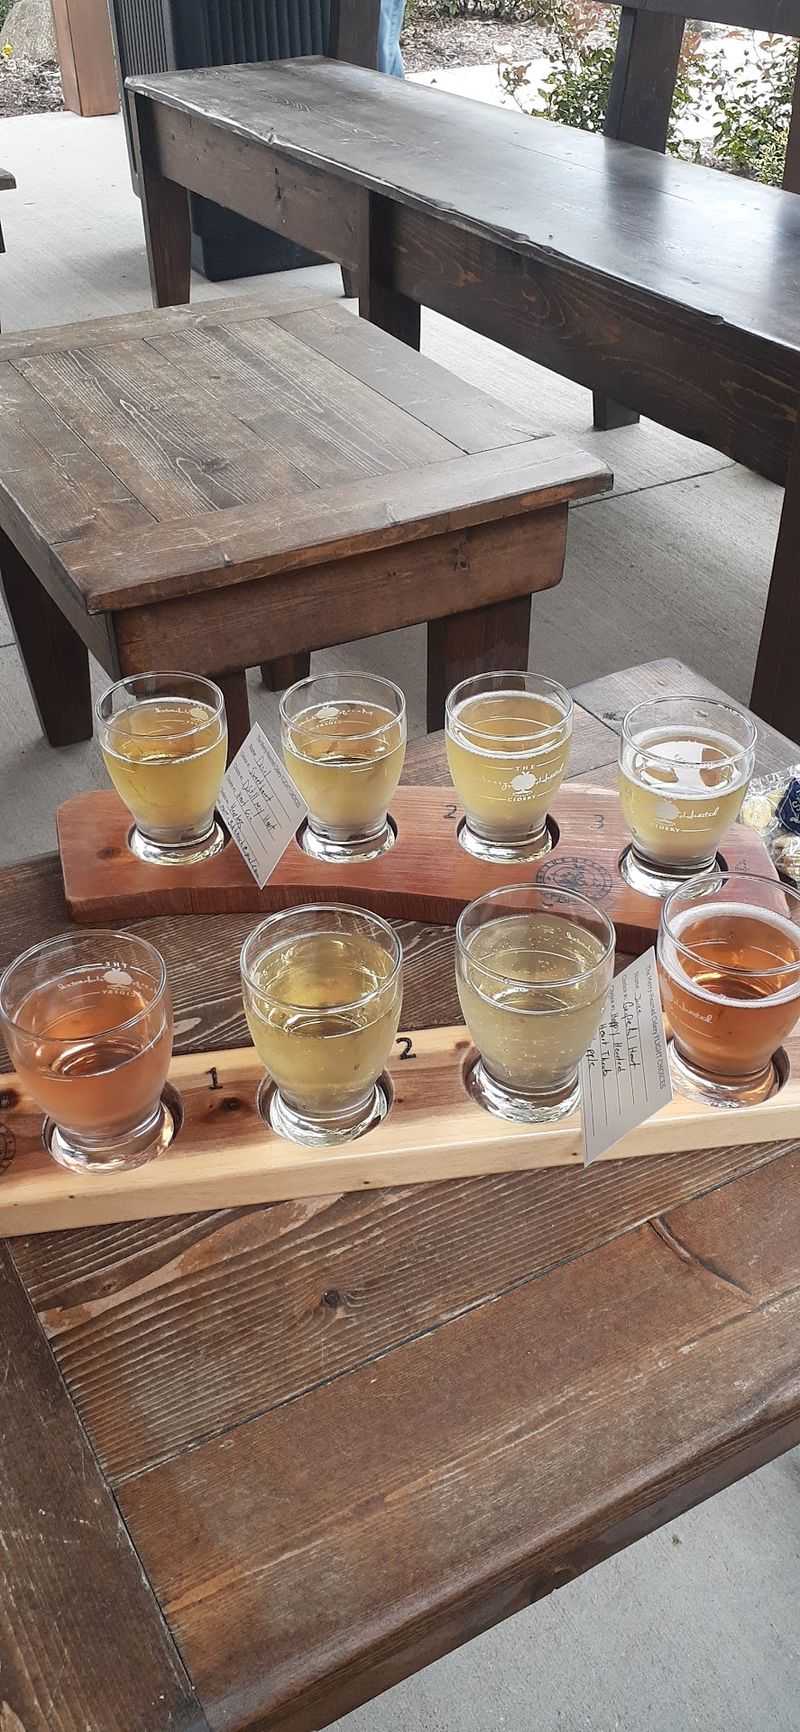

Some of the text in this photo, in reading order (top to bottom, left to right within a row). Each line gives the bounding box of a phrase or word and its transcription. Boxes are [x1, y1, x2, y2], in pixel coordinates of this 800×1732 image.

[443, 804, 457, 819] 2
[395, 1037, 416, 1060] 2
[205, 1066, 223, 1090] 1
